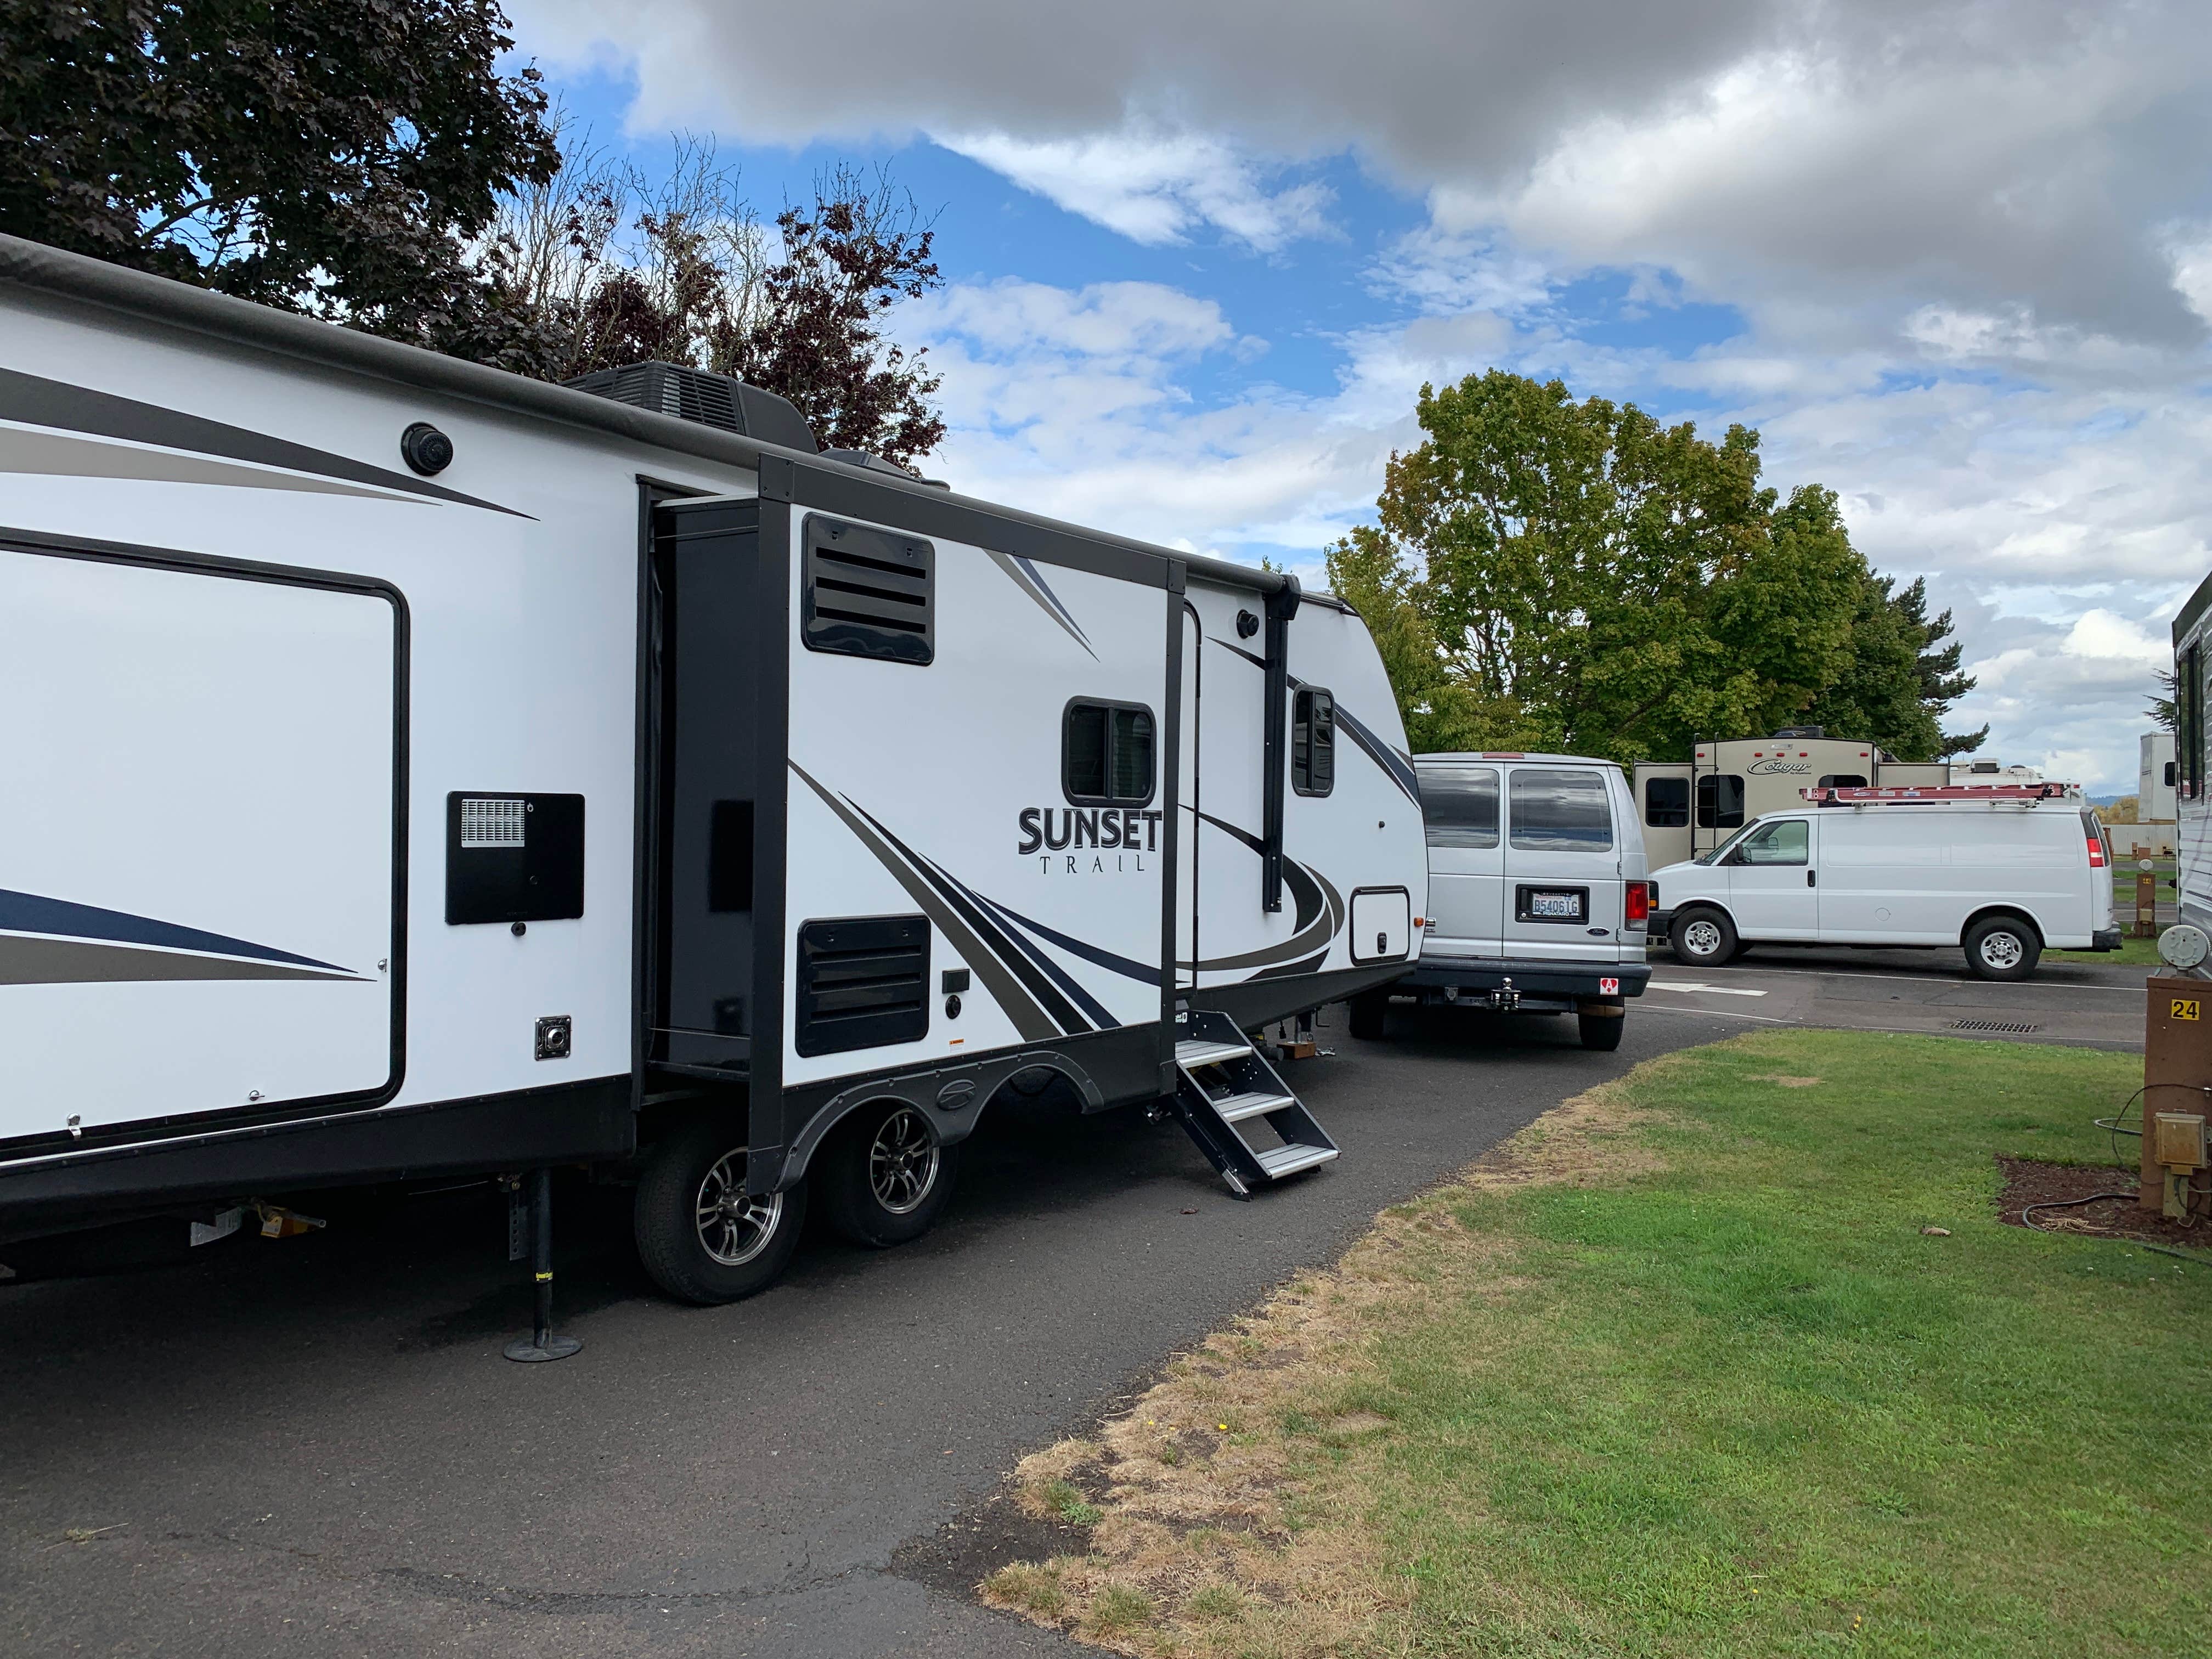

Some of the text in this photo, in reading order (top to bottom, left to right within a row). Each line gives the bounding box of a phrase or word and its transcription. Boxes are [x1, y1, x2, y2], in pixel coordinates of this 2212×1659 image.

[1747, 758, 1812, 775] Cougar
[1018, 807, 1163, 855] SUNSET
[1040, 854, 1145, 874] TRAIL
[1534, 900, 1578, 912] B54061G
[2172, 1001, 2198, 1019] 24
